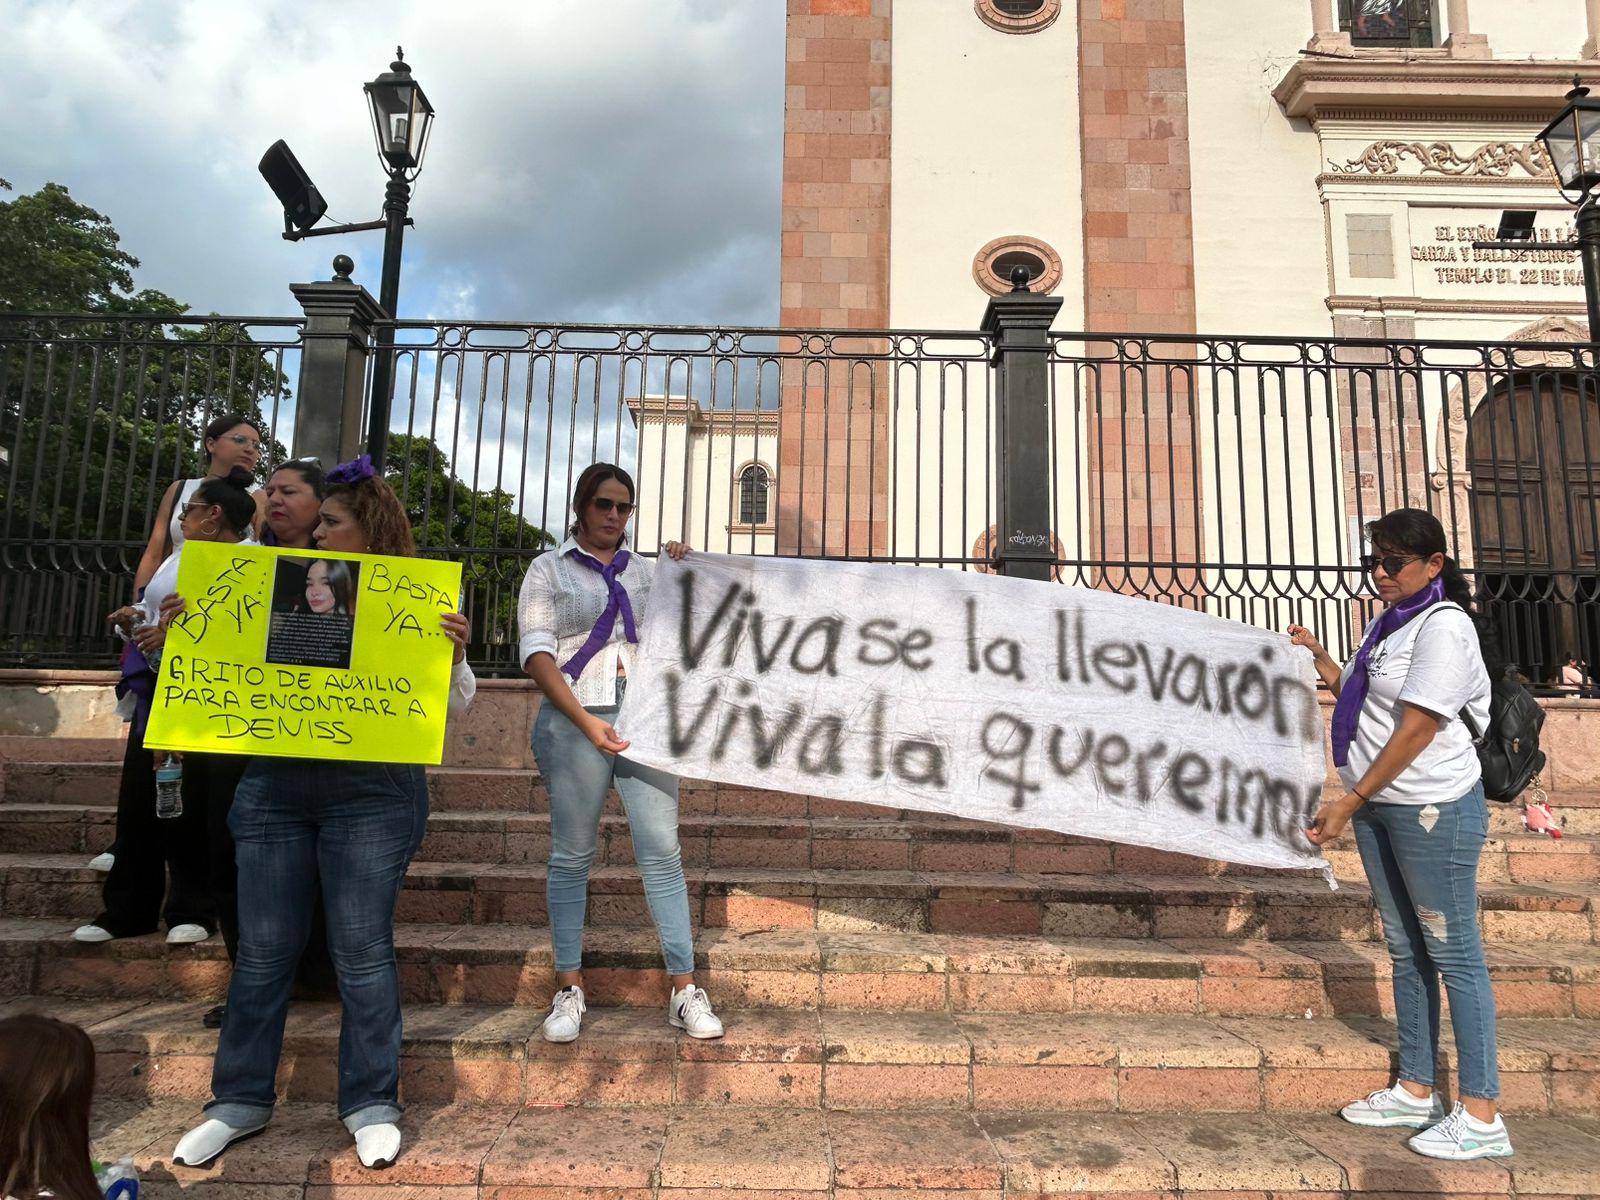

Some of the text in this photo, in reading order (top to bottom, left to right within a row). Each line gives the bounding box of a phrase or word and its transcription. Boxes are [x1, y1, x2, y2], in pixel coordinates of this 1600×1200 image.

[1434, 266, 1493, 284] TEMPLO
[1520, 268, 1539, 285] 22
[1541, 269, 1561, 286] DE
[170, 557, 256, 644] BASTA
[367, 563, 453, 609] BASTA
[677, 570, 846, 678] Viva
[857, 618, 933, 671] se
[965, 597, 1026, 682] la
[170, 655, 264, 686] GRITO
[277, 669, 311, 690] DE
[164, 685, 427, 719] PARA ENCONTRAR A
[208, 713, 353, 745] DENISS
[664, 671, 845, 776] Viva
[871, 686, 948, 789] la
